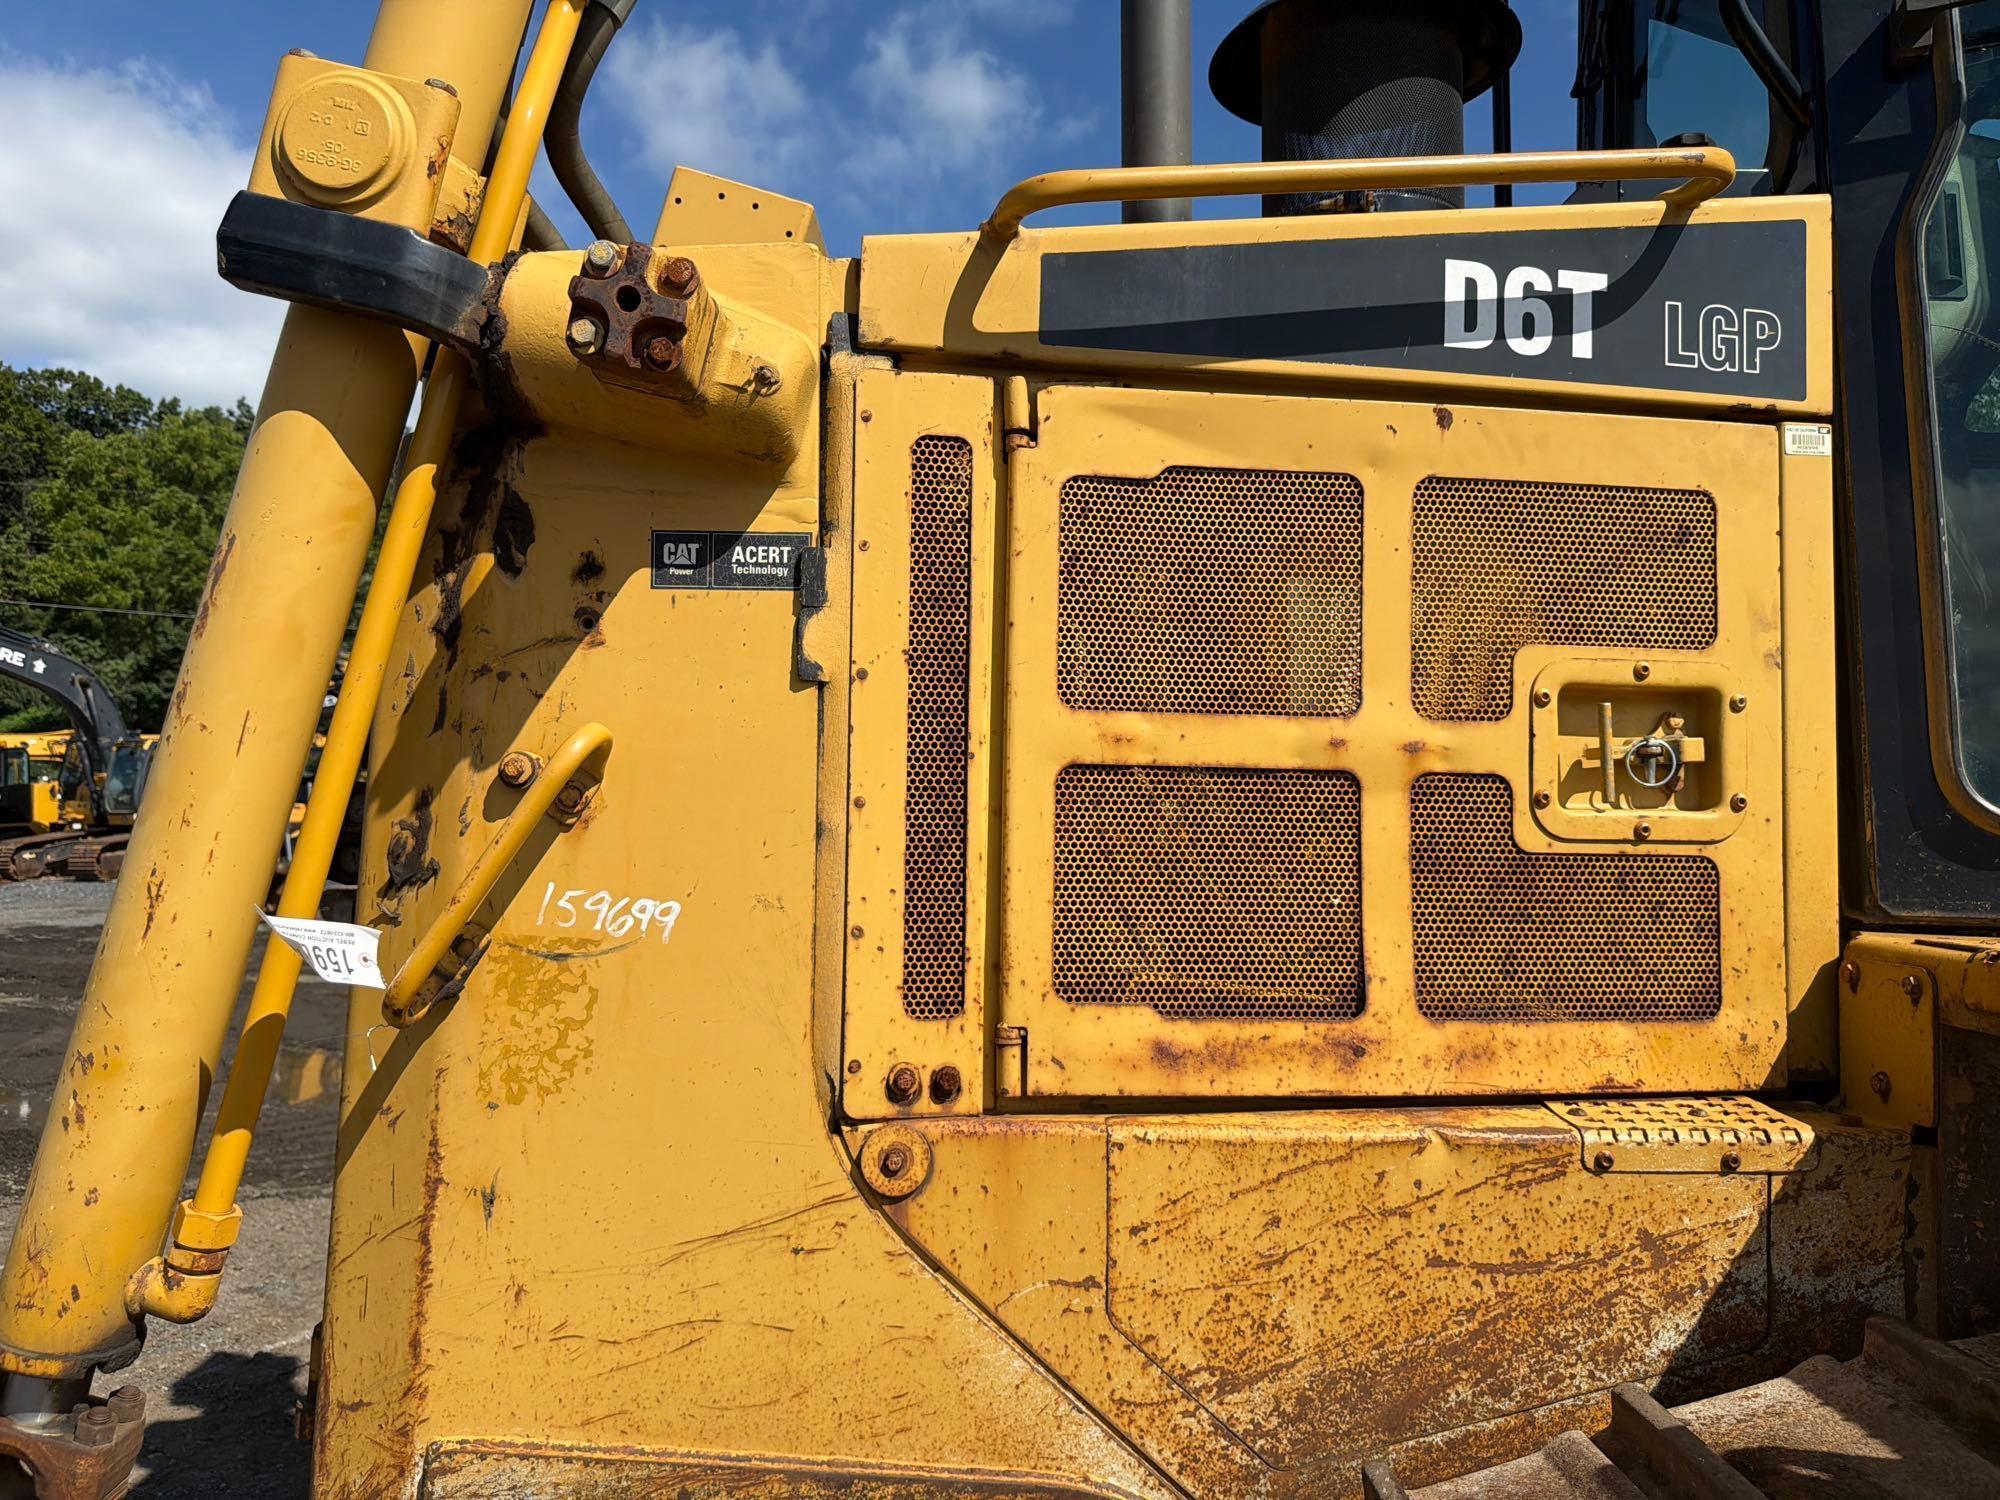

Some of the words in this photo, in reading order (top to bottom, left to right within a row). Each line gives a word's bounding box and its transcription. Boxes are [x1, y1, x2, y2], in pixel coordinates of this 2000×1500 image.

[1444, 258, 1608, 359] D6T
[1664, 301, 1782, 373] LGP
[663, 542, 700, 565] CAT
[731, 546, 791, 564] ACERT
[669, 567, 694, 575] Power
[731, 564, 789, 577] Technology
[536, 881, 682, 944] 159699
